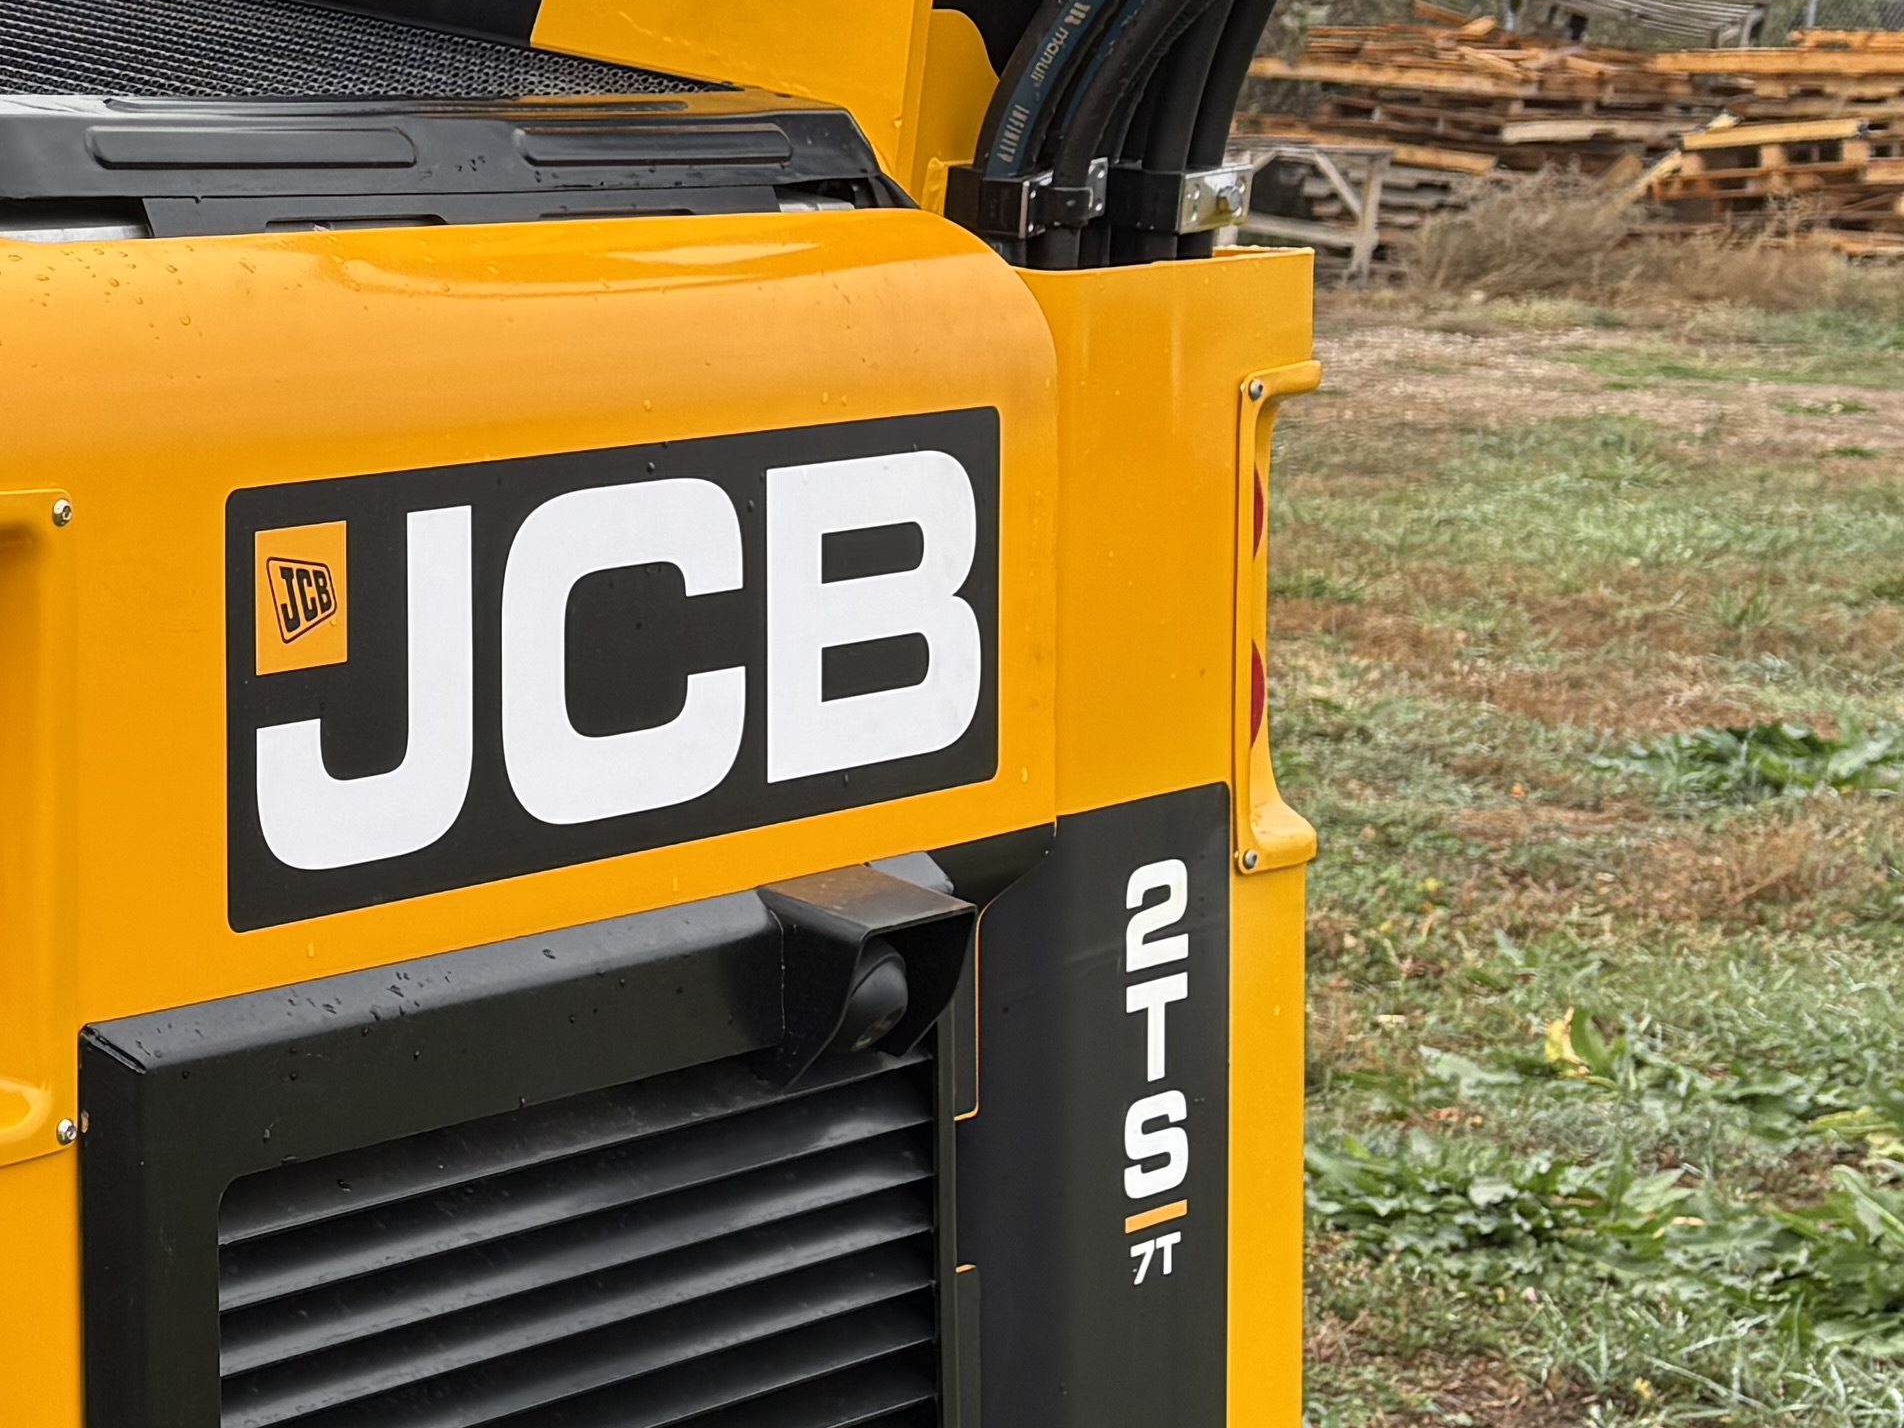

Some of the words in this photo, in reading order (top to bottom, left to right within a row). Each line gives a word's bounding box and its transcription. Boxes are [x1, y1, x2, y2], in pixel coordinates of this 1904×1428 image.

[1030, 26, 1069, 82] manuli
[280, 568, 332, 632] JCB
[256, 450, 981, 870] JCB
[1130, 1231, 1181, 1285] 7T
